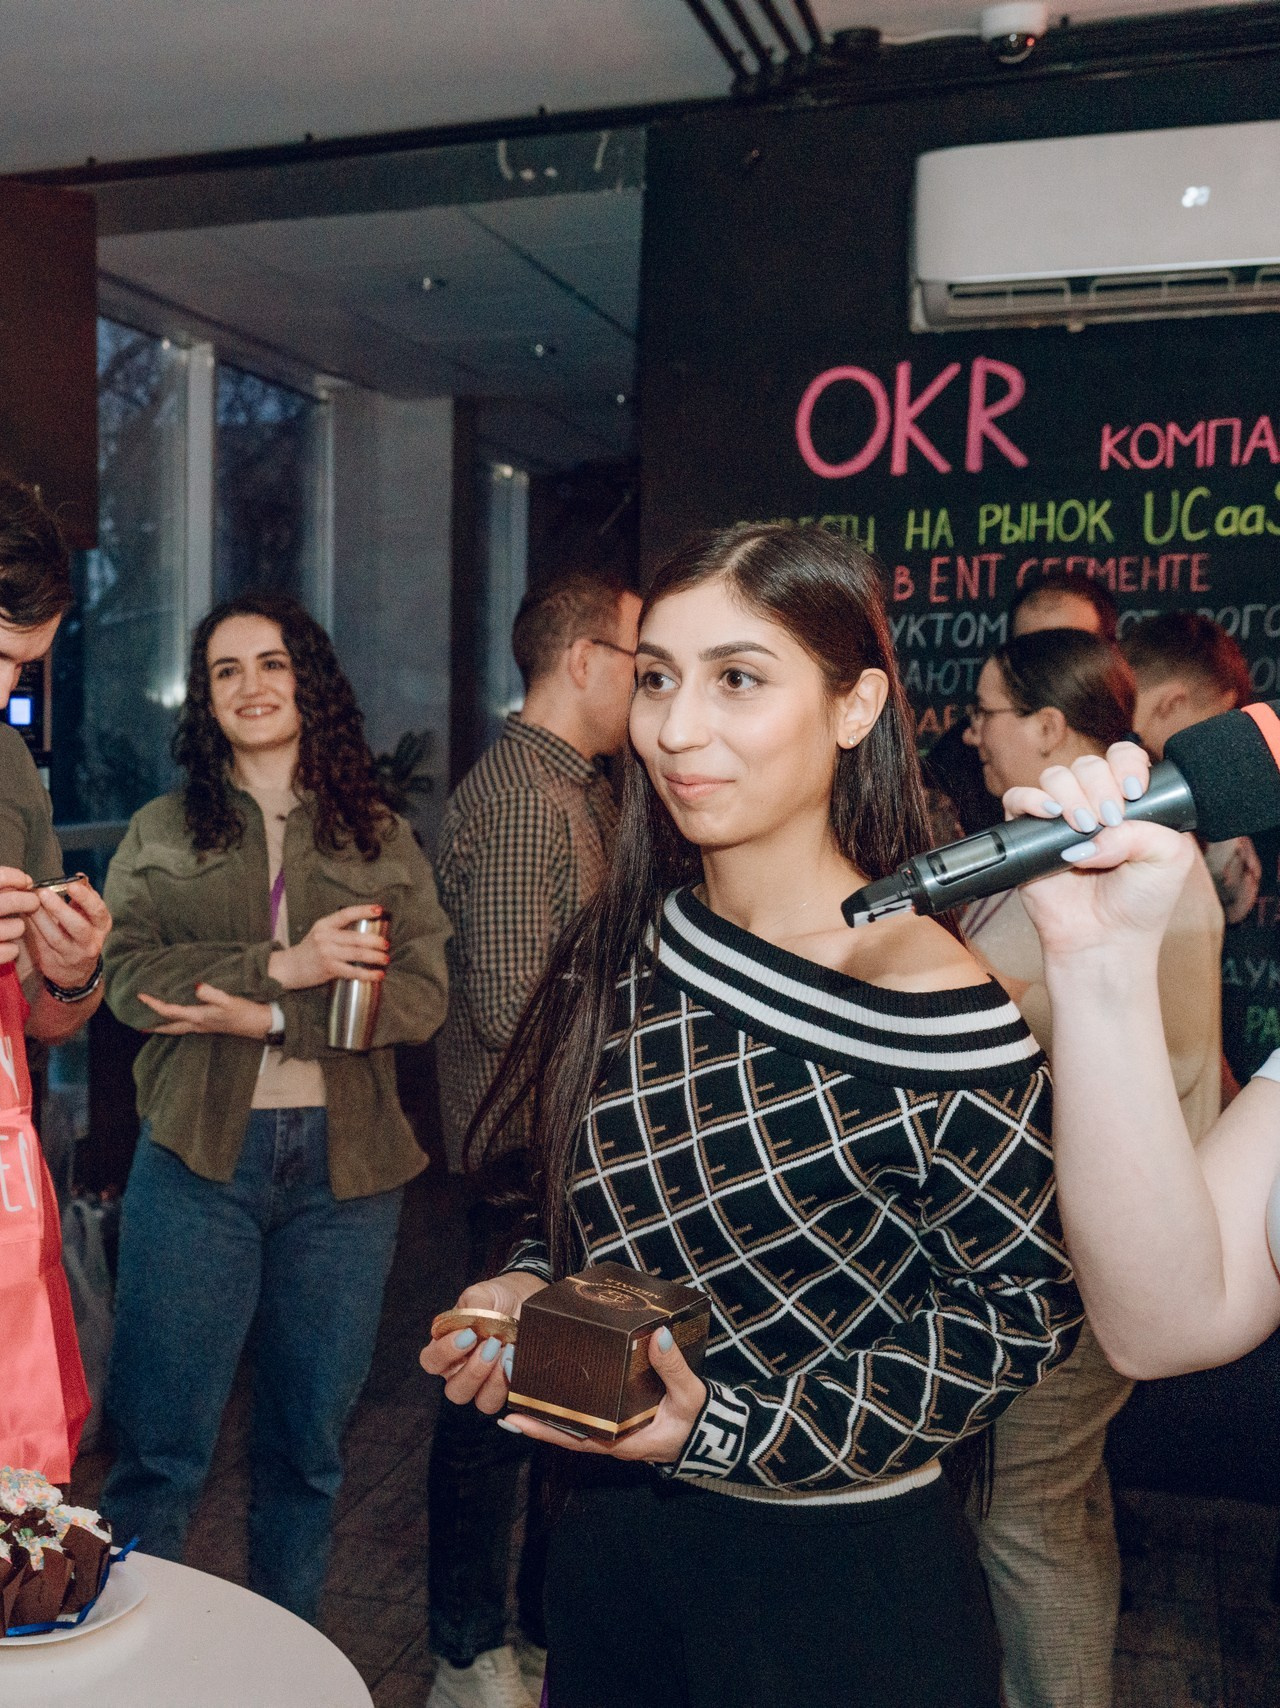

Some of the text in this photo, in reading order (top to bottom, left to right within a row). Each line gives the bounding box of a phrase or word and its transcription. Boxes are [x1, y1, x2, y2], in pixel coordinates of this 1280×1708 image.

[795, 356, 1029, 479] OKR
[904, 507, 954, 551] НА
[978, 499, 1115, 546] РЫНОК
[893, 565, 916, 601] В
[929, 553, 1006, 603] ENT
